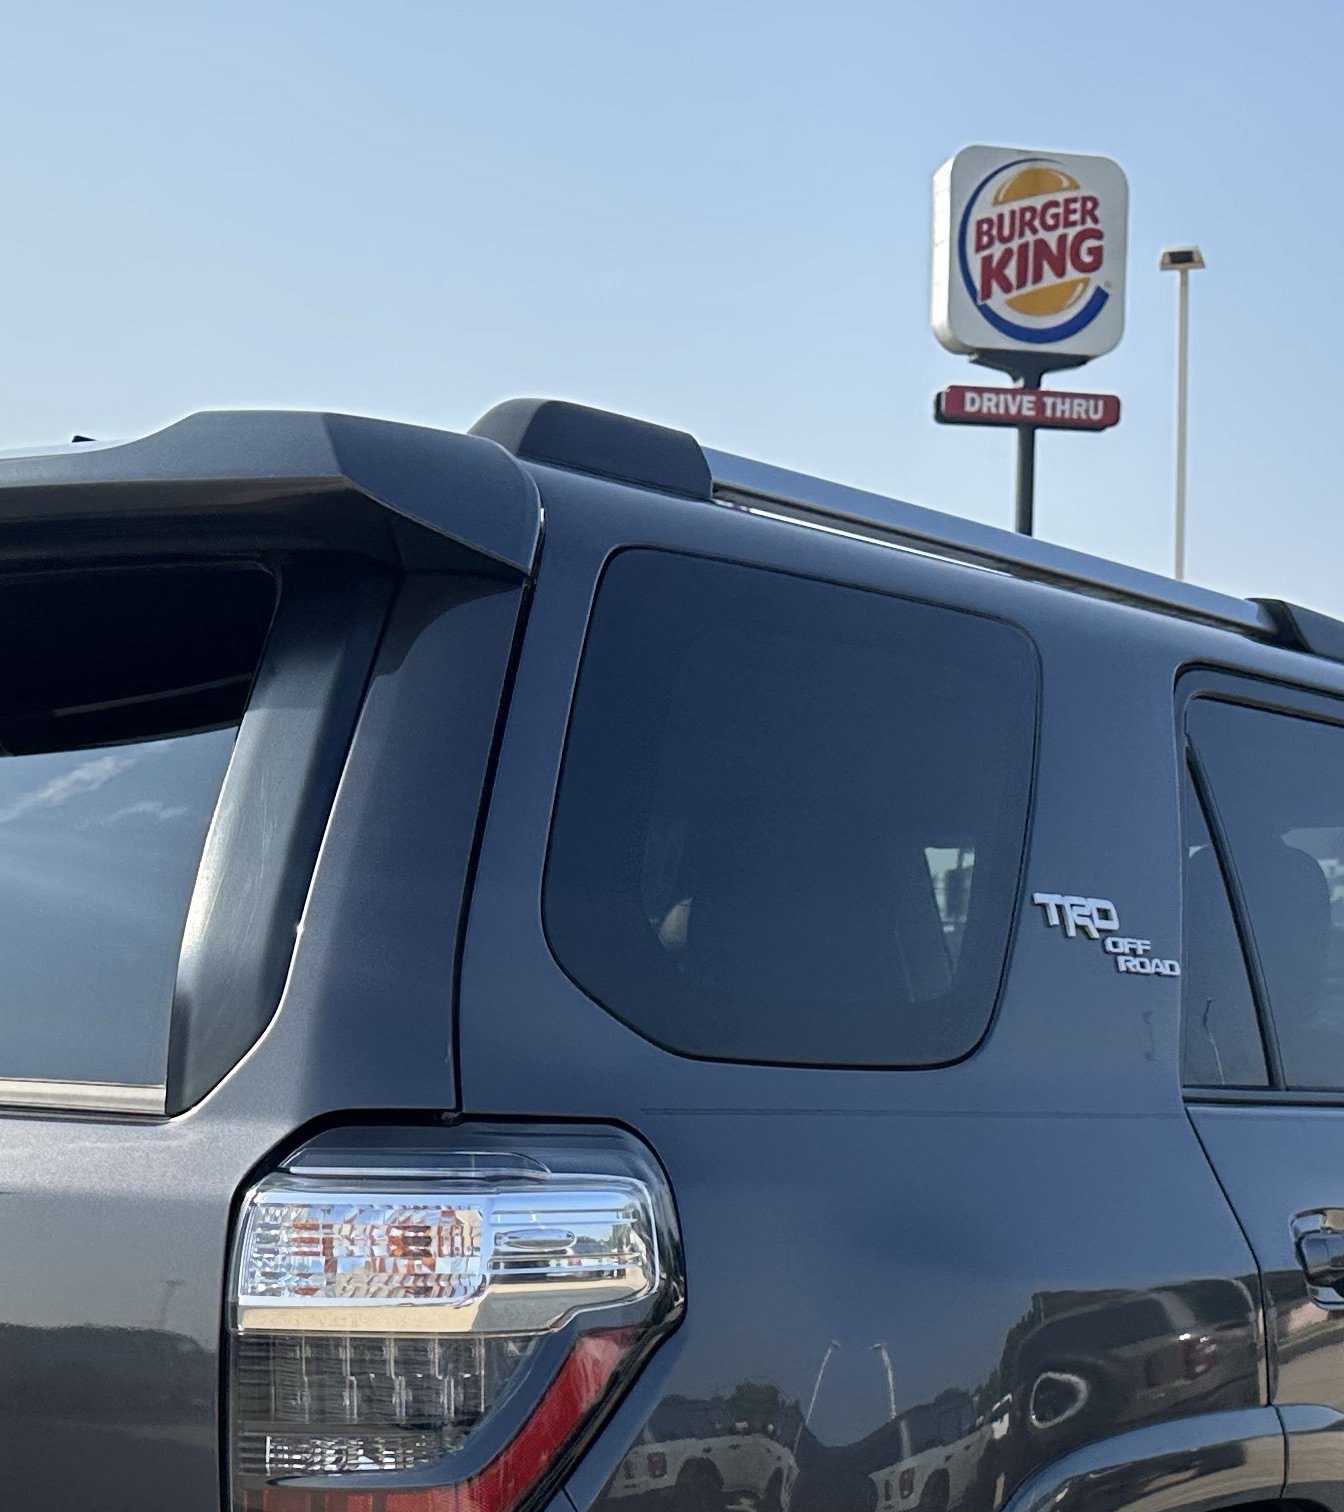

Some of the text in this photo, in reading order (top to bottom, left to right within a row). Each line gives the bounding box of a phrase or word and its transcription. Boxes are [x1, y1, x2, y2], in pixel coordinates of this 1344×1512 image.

[975, 195, 1100, 254] BURGER
[980, 227, 1105, 302] KING
[963, 391, 1104, 421] DRIVE THRU
[1033, 892, 1120, 940] TRD
[1105, 936, 1152, 955] OFF
[1116, 955, 1181, 977] ROAD
